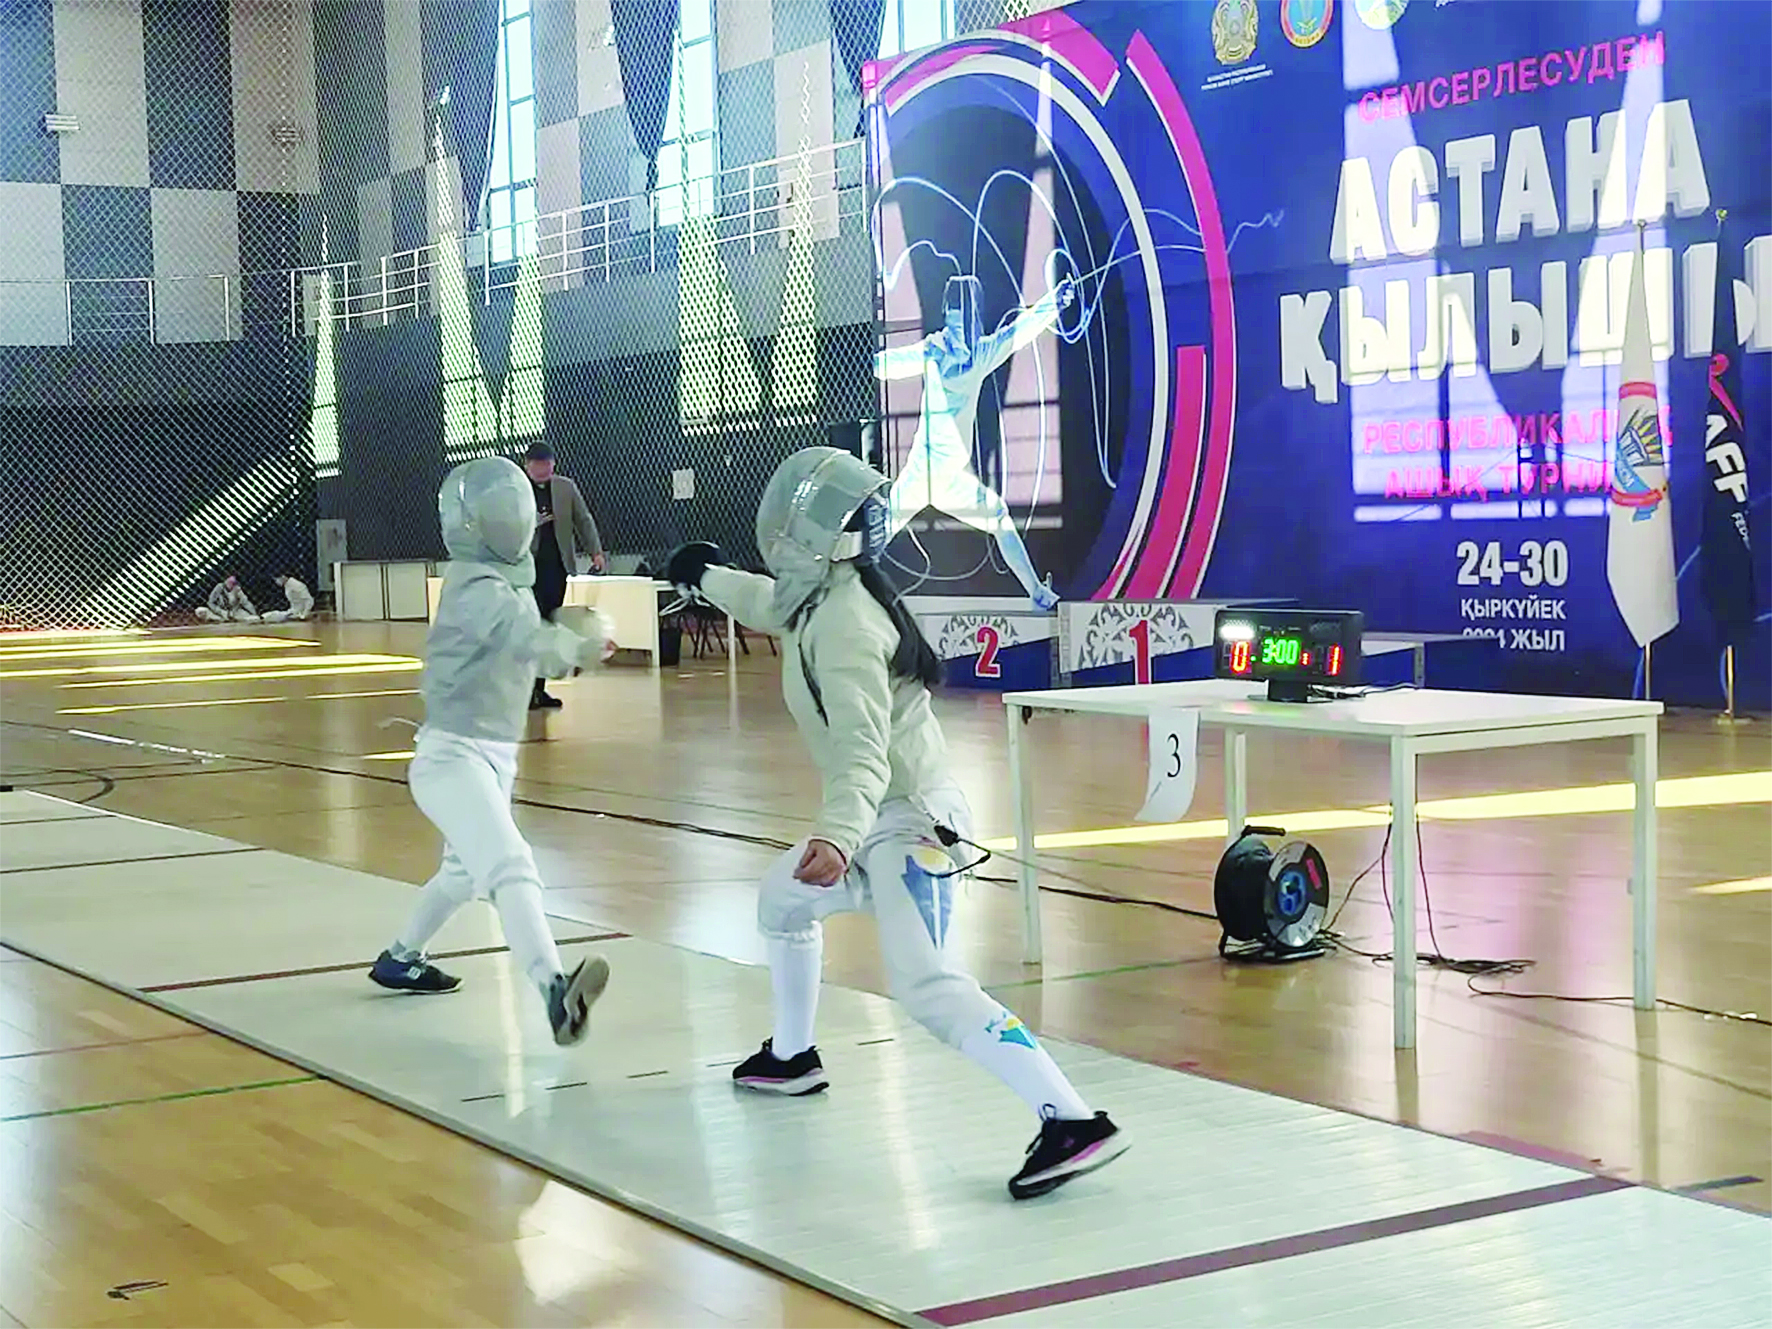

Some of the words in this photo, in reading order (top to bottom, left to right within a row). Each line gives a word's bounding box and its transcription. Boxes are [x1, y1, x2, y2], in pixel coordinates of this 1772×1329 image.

[1358, 30, 1665, 124] СЕМСЕРЛЕСУДЕН
[1330, 99, 1711, 265] АСТАНА
[1385, 464, 1489, 502] АШЫҚ
[1457, 541, 1569, 587] 24-30
[1461, 594, 1567, 621] ҚЫРКҮЙЕК
[976, 626, 1000, 677] 2
[1129, 619, 1152, 685] 1
[1231, 640, 1252, 674] 0
[1261, 636, 1302, 666] 3:00
[1328, 643, 1343, 676] 1
[1510, 628, 1565, 651] ЖЫЛ
[1166, 733, 1182, 778] 3
